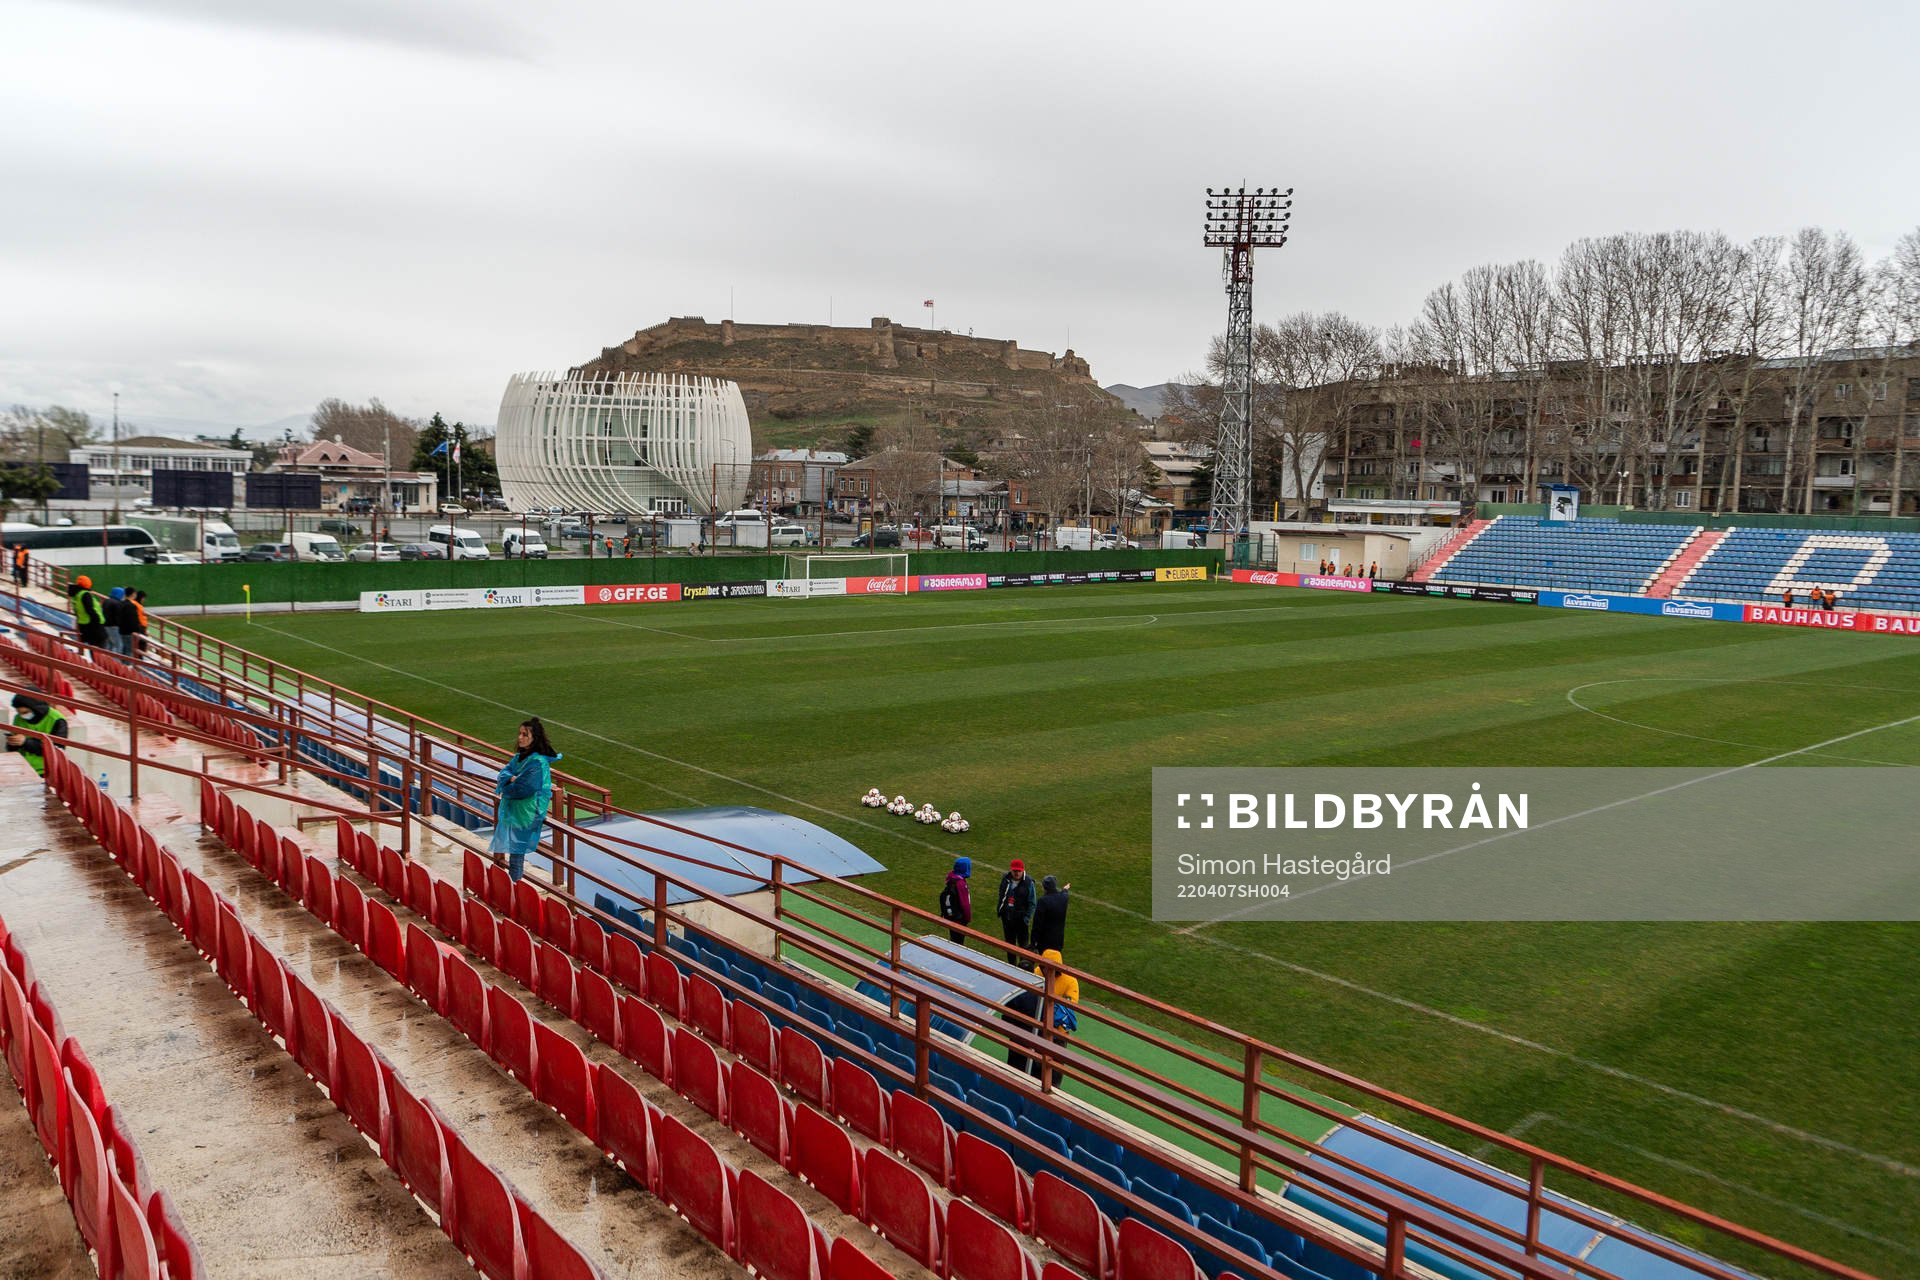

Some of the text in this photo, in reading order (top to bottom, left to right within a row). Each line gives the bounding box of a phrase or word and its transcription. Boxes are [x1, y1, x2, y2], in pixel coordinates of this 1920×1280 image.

[1172, 569, 1199, 579] ELIGA.GE
[1372, 581, 1395, 589] UNIBET
[614, 587, 668, 601] GFF.GE
[683, 585, 720, 599] Crystalbet
[1511, 591, 1537, 599] UNIBET
[384, 598, 412, 607] STARI
[493, 595, 522, 604] STARI
[1752, 608, 1856, 627] BAUHAUS
